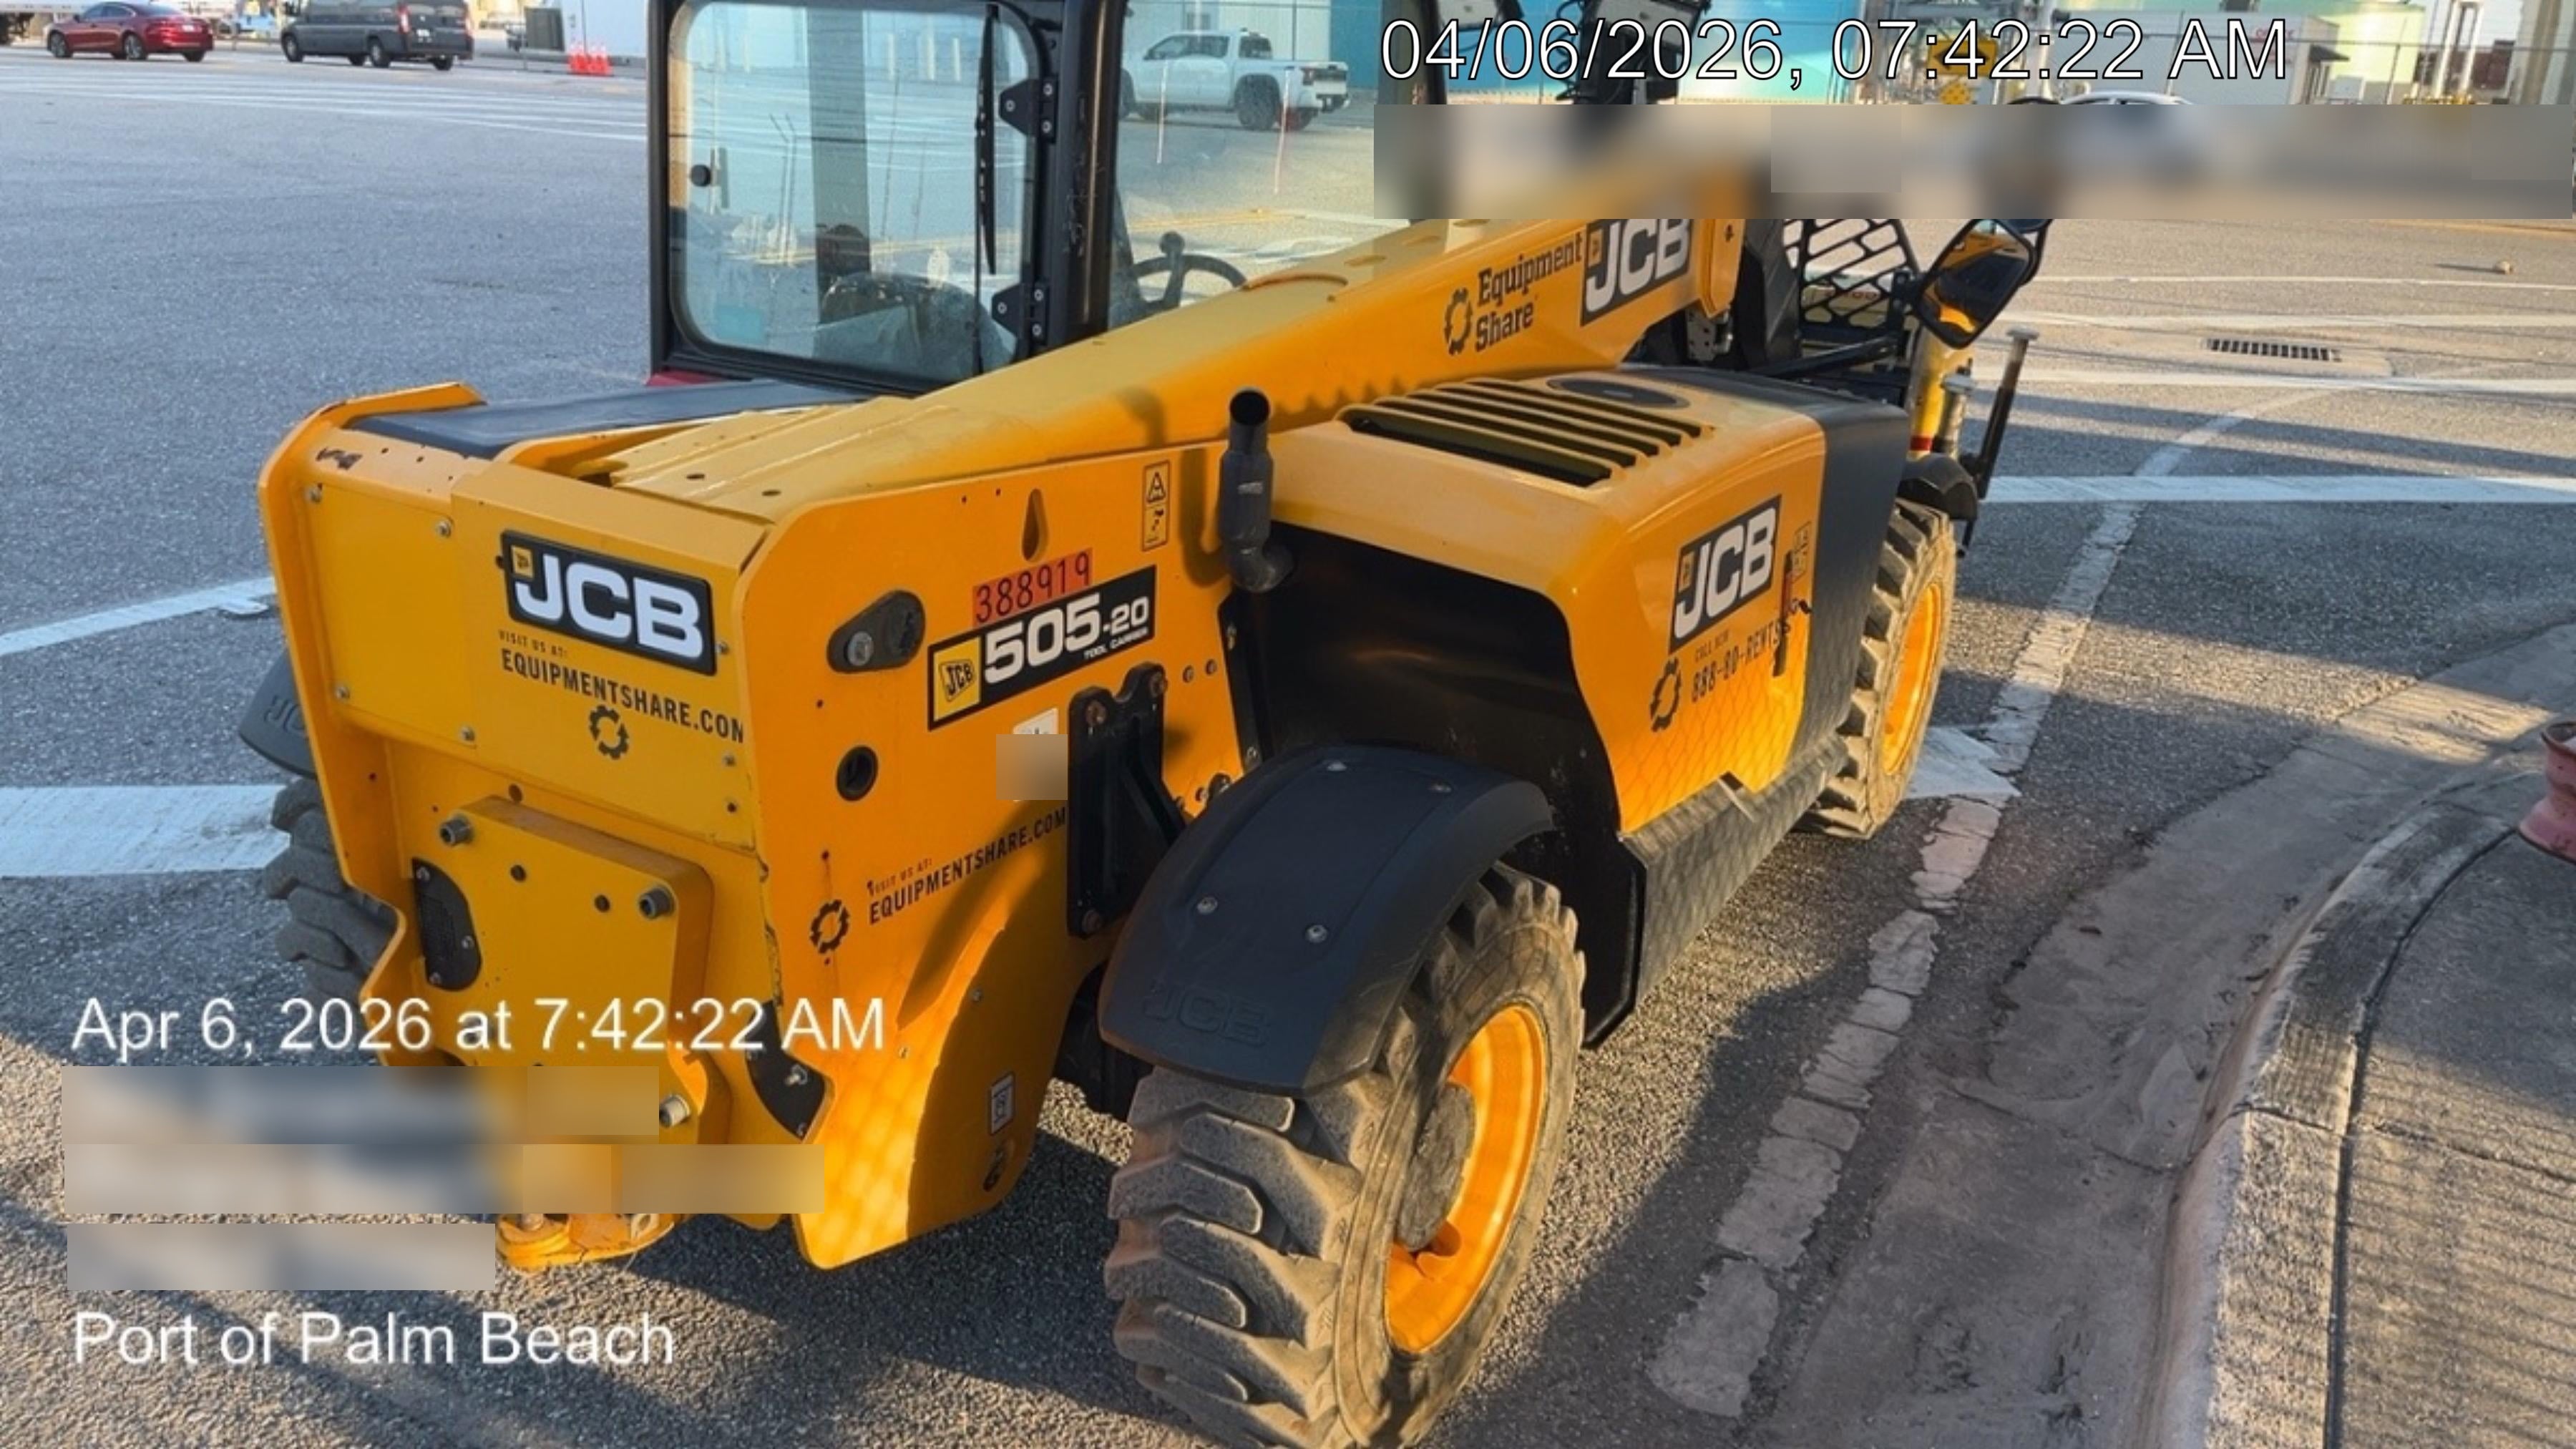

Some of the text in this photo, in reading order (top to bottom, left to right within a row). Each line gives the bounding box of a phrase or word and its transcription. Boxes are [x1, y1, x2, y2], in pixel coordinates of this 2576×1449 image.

[1478, 233, 1583, 308] Equipment
[1586, 219, 1689, 312] JCB
[1475, 302, 1533, 352] Share
[514, 553, 703, 658] JCB
[975, 551, 1090, 624] 388919
[1674, 507, 1776, 638] JCB
[945, 659, 975, 697] JCB
